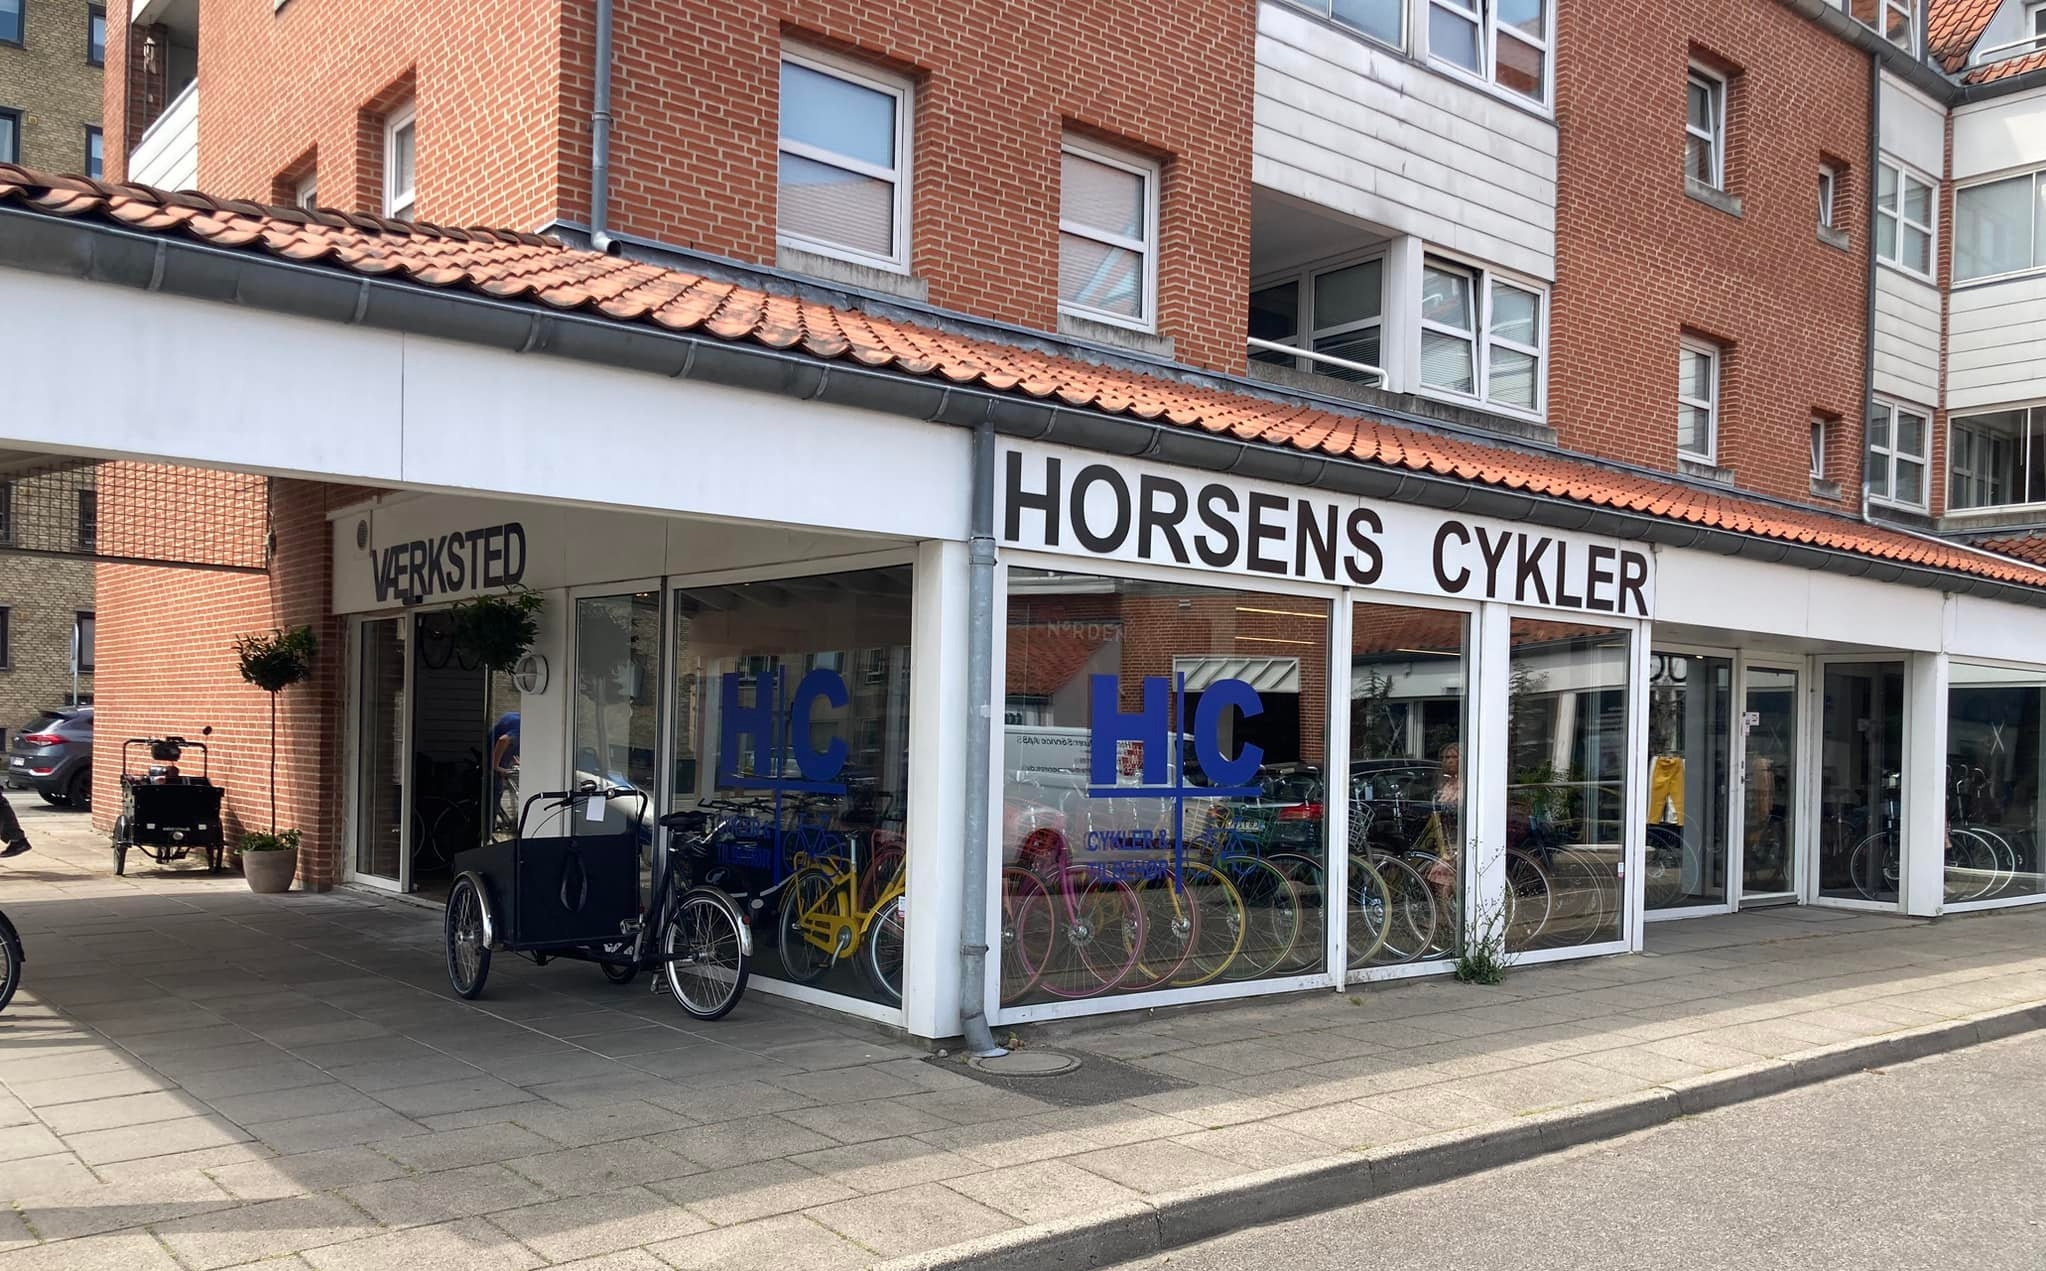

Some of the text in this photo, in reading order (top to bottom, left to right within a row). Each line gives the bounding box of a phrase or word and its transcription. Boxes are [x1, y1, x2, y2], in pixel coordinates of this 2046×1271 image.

[371, 522, 526, 602] VÆRKSTED
[1005, 451, 1649, 616] HORSENS CYKLER
[1088, 830, 1154, 852] CYKLER
